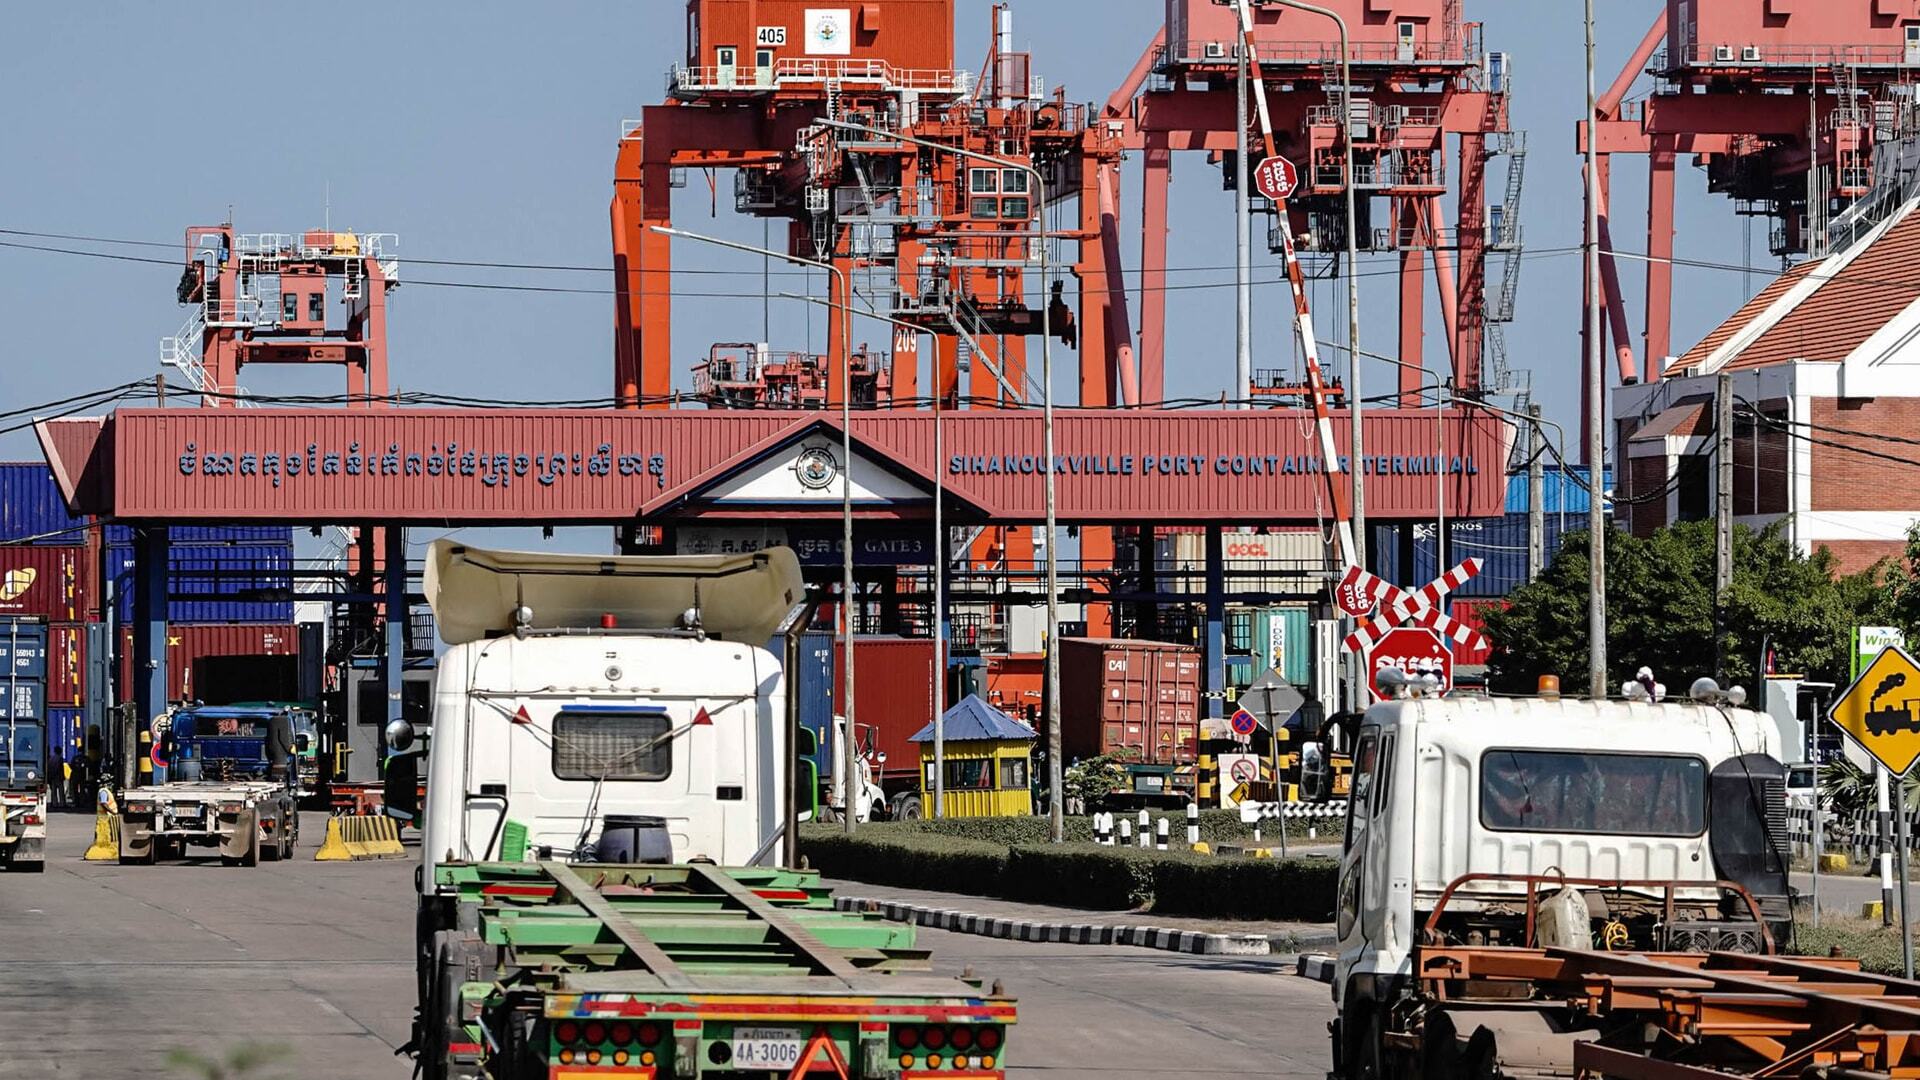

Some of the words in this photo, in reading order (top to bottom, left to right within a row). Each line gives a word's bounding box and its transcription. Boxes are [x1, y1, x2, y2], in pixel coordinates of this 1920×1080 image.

[759, 28, 784, 43] 405
[1263, 166, 1275, 192] STOP
[895, 327, 917, 353] 209
[949, 454, 1134, 475] SIHANOUKVILLE
[1142, 454, 1206, 475] PORT
[1214, 454, 1350, 476] CONTAINR
[1361, 454, 1478, 476] TERMINAL
[1428, 522, 1483, 531] CNOS
[864, 539, 909, 553] GATE
[912, 539, 923, 553] 3
[1227, 543, 1269, 557] OOCL
[123, 560, 135, 568] NY
[1343, 584, 1356, 610] STOP
[1108, 659, 1126, 671] CAI
[736, 1042, 798, 1062] 4A-3006
